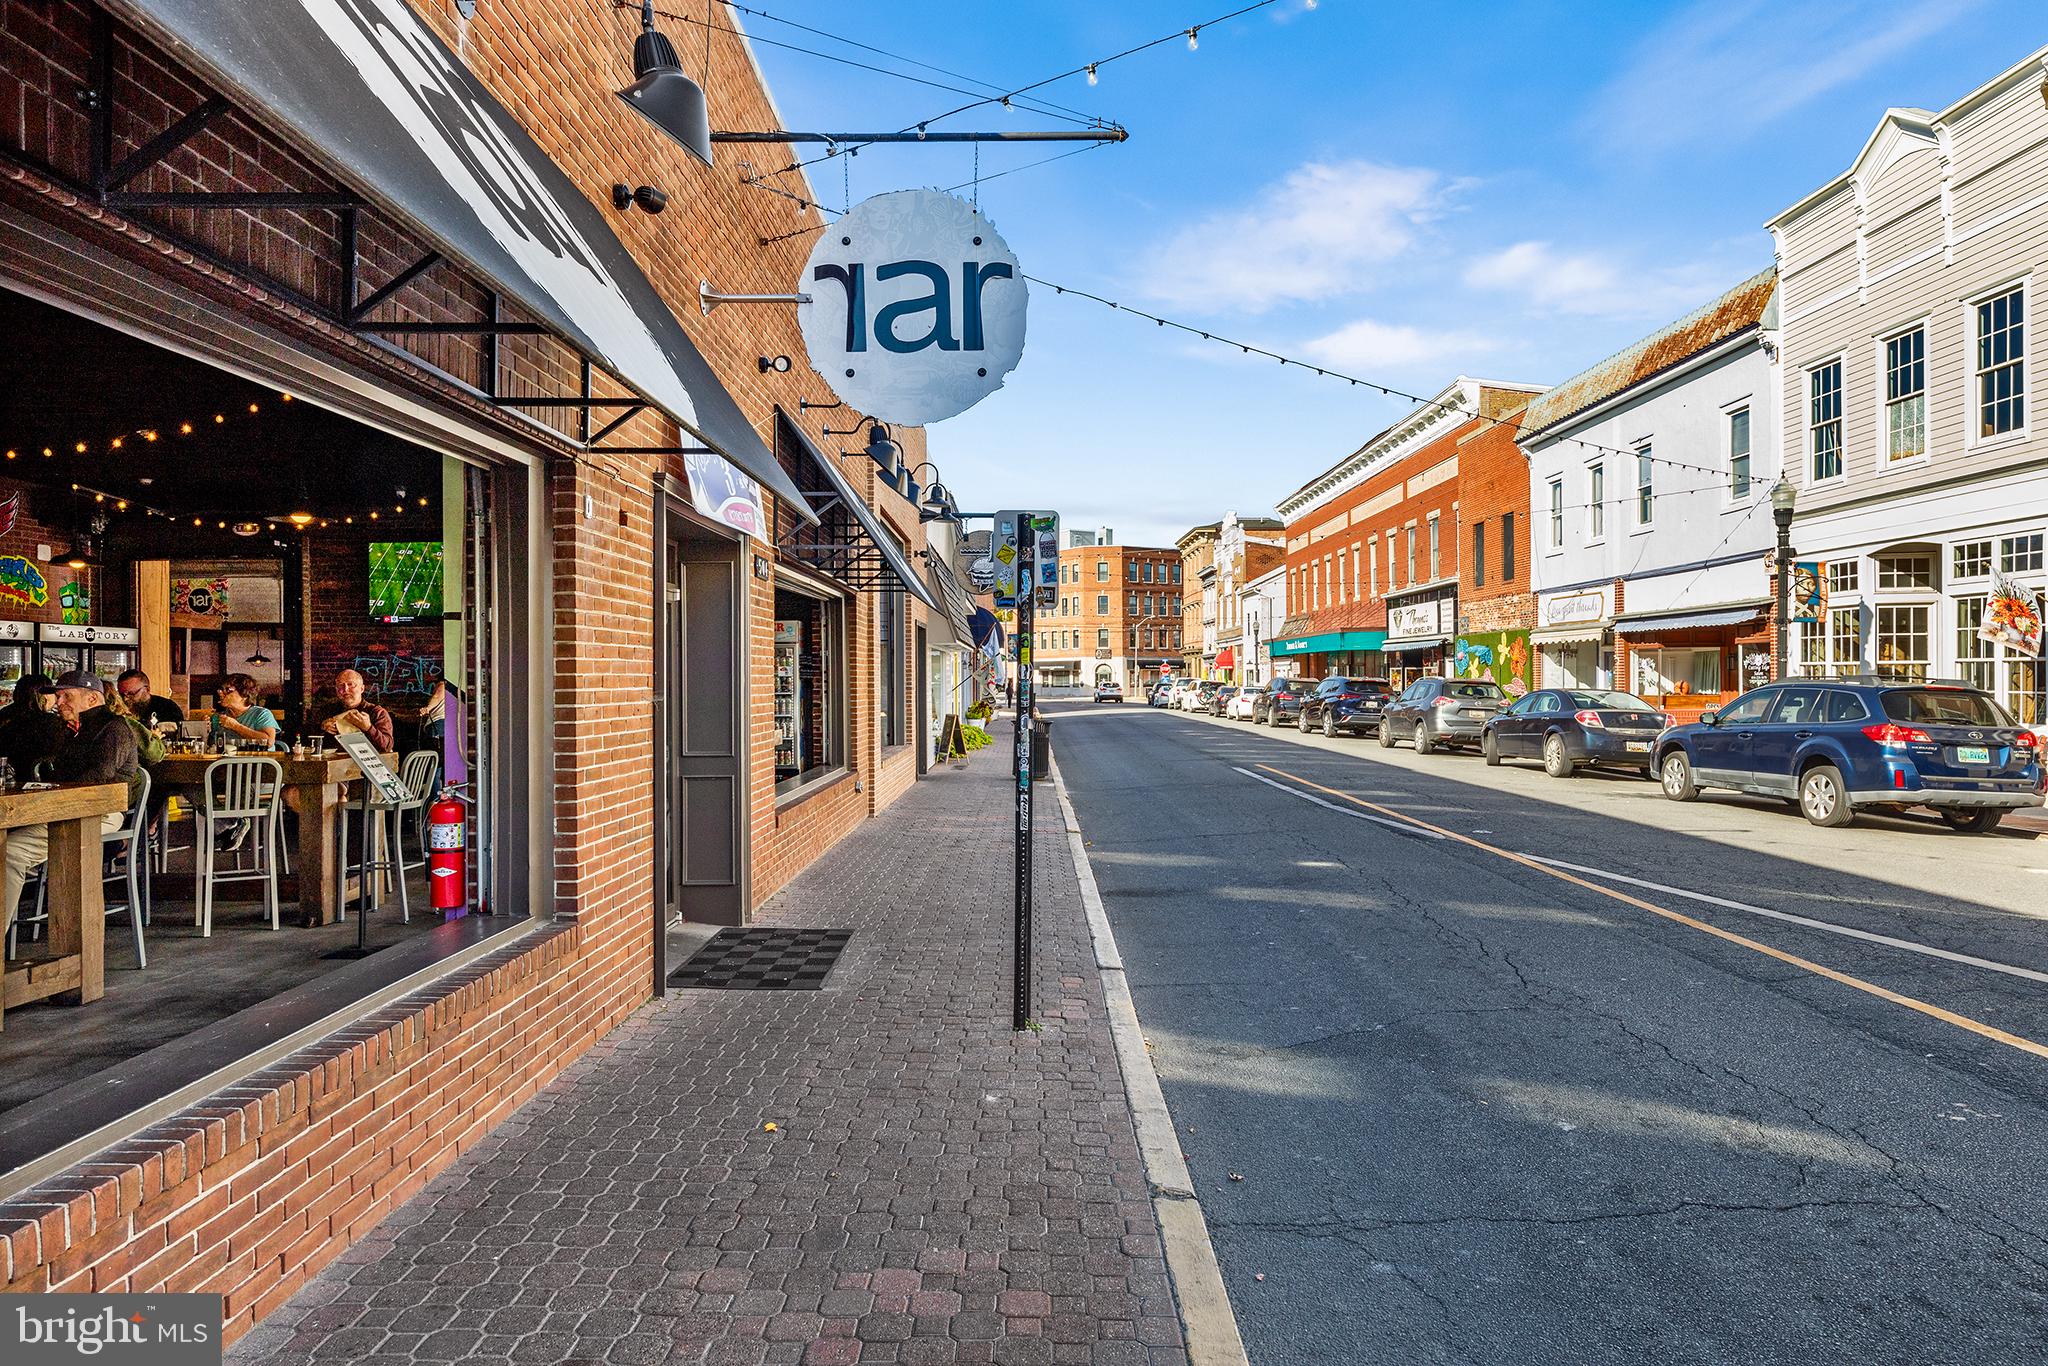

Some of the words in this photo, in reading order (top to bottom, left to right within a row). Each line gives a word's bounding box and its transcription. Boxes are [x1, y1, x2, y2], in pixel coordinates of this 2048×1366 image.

[814, 260, 1013, 353] rar
[1402, 628, 1412, 636] FINE
[1412, 626, 1433, 635] JEWELRY
